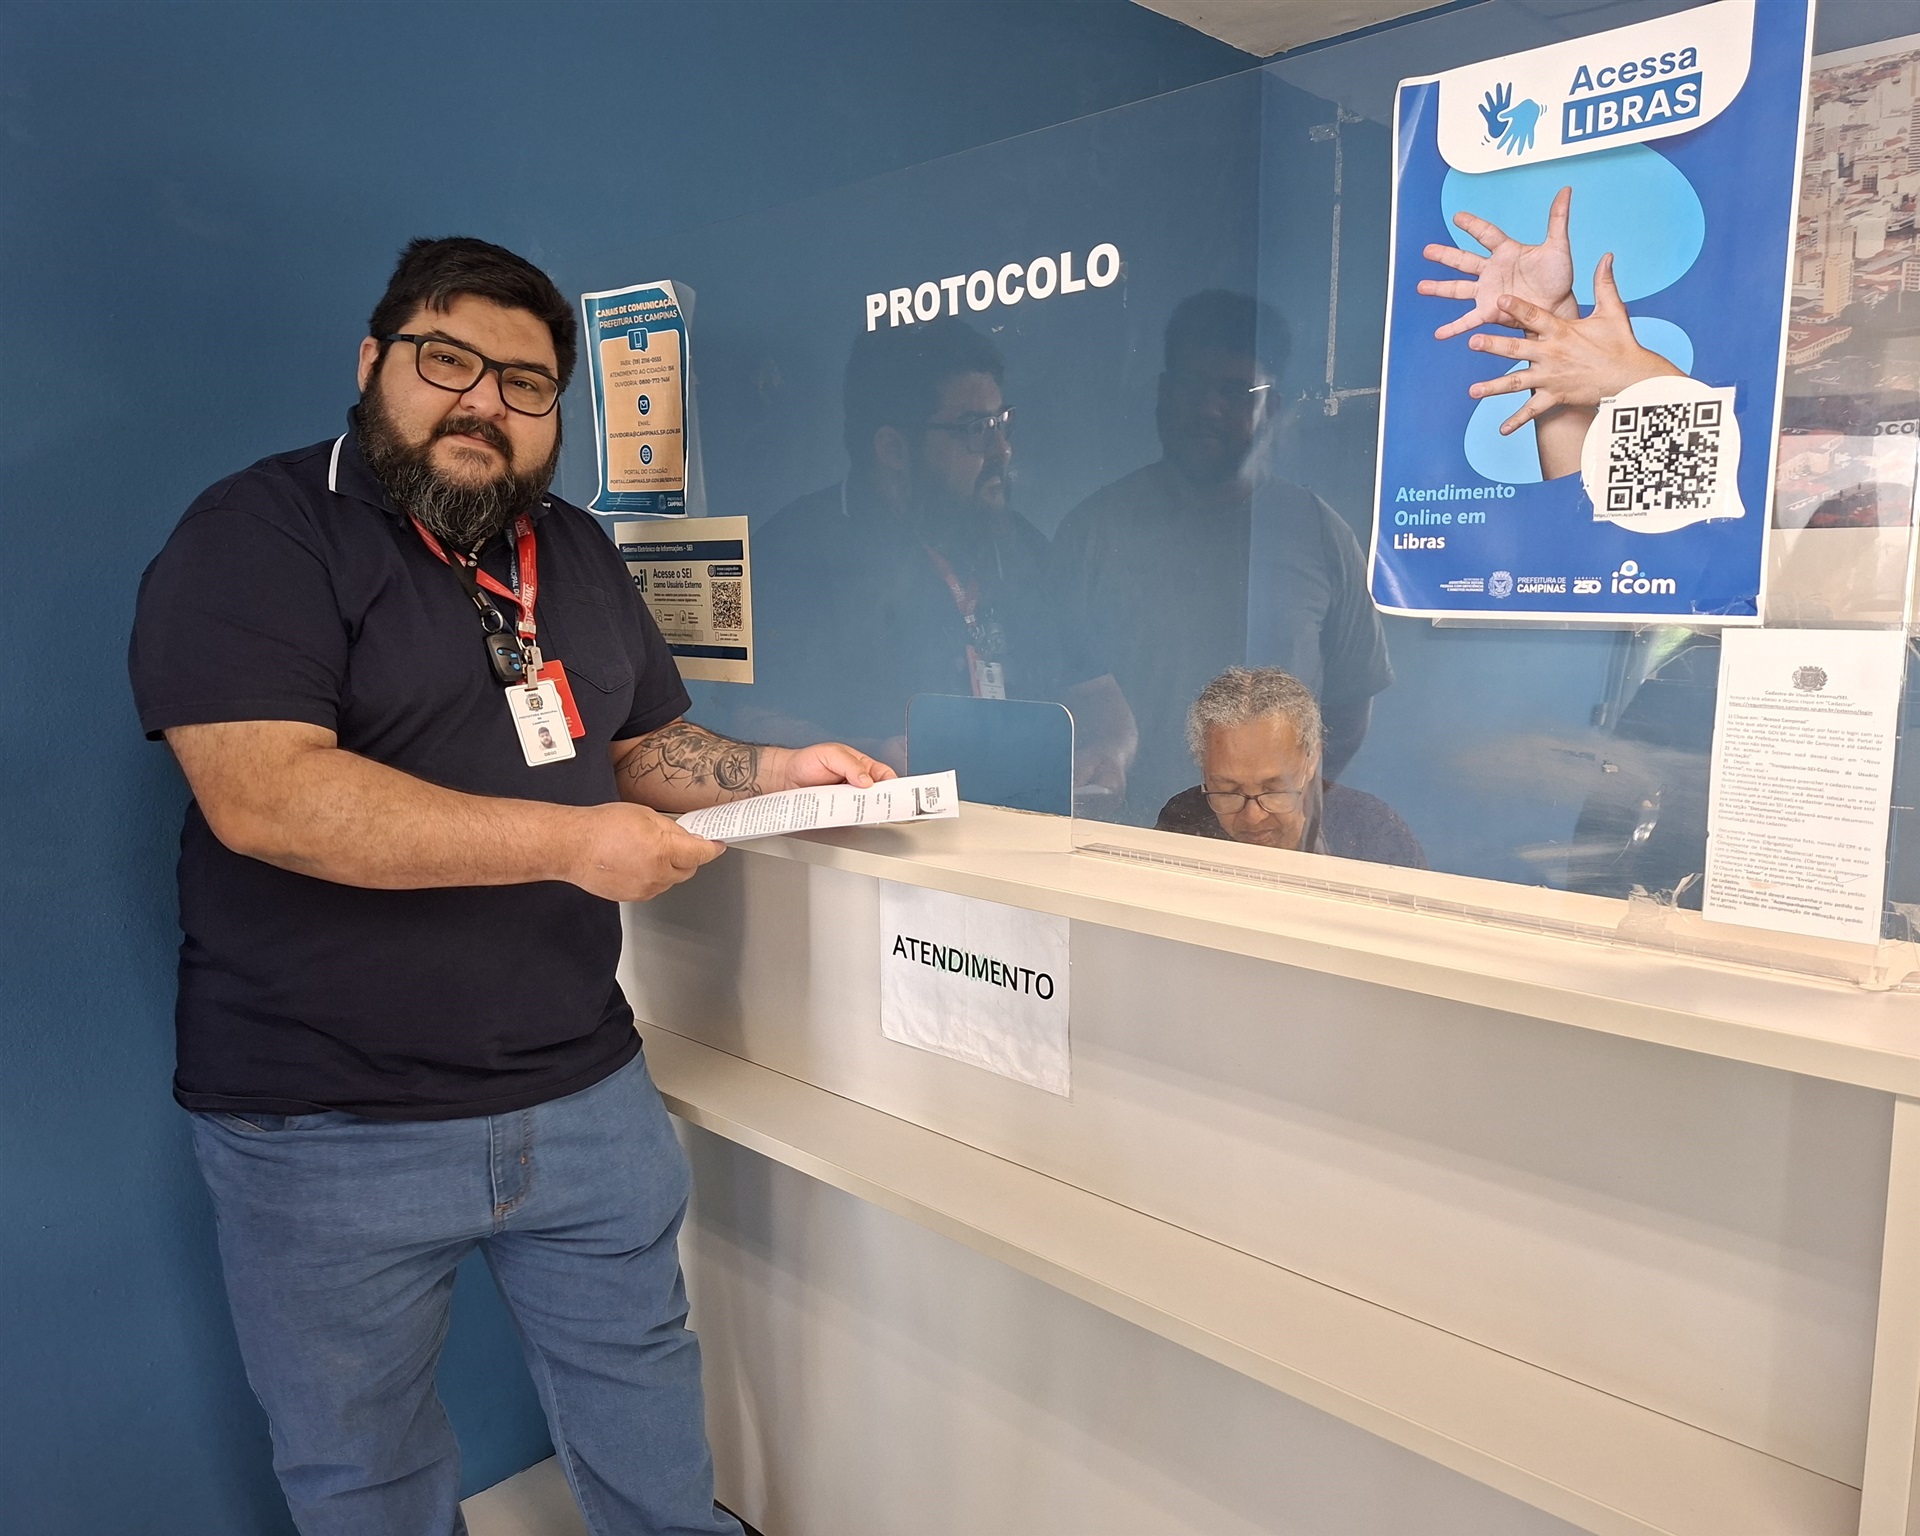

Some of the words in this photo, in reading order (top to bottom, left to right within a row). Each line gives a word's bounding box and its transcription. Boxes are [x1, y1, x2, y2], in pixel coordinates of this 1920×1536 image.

[1568, 46, 1698, 95] Acessa
[1567, 81, 1699, 138] LIBRAS
[865, 242, 1120, 332] PROTOCOLO
[595, 307, 618, 318] CANAIS
[619, 306, 627, 314] DE
[600, 317, 633, 329] PREFEITURA
[633, 315, 643, 323] DE
[644, 309, 677, 322] CAMPINAS
[1395, 484, 1516, 503] Atendimento
[1394, 509, 1452, 526] Online
[1457, 511, 1486, 524] em
[1393, 533, 1446, 550] Libras
[653, 568, 675, 578] Acesse
[681, 567, 692, 578] SEI
[666, 580, 684, 589] Usuário
[684, 580, 702, 589] Externo
[1516, 583, 1567, 593] CAMPINAS
[1610, 571, 1676, 594] icom
[892, 934, 1054, 1000] ATENDIMENTO
